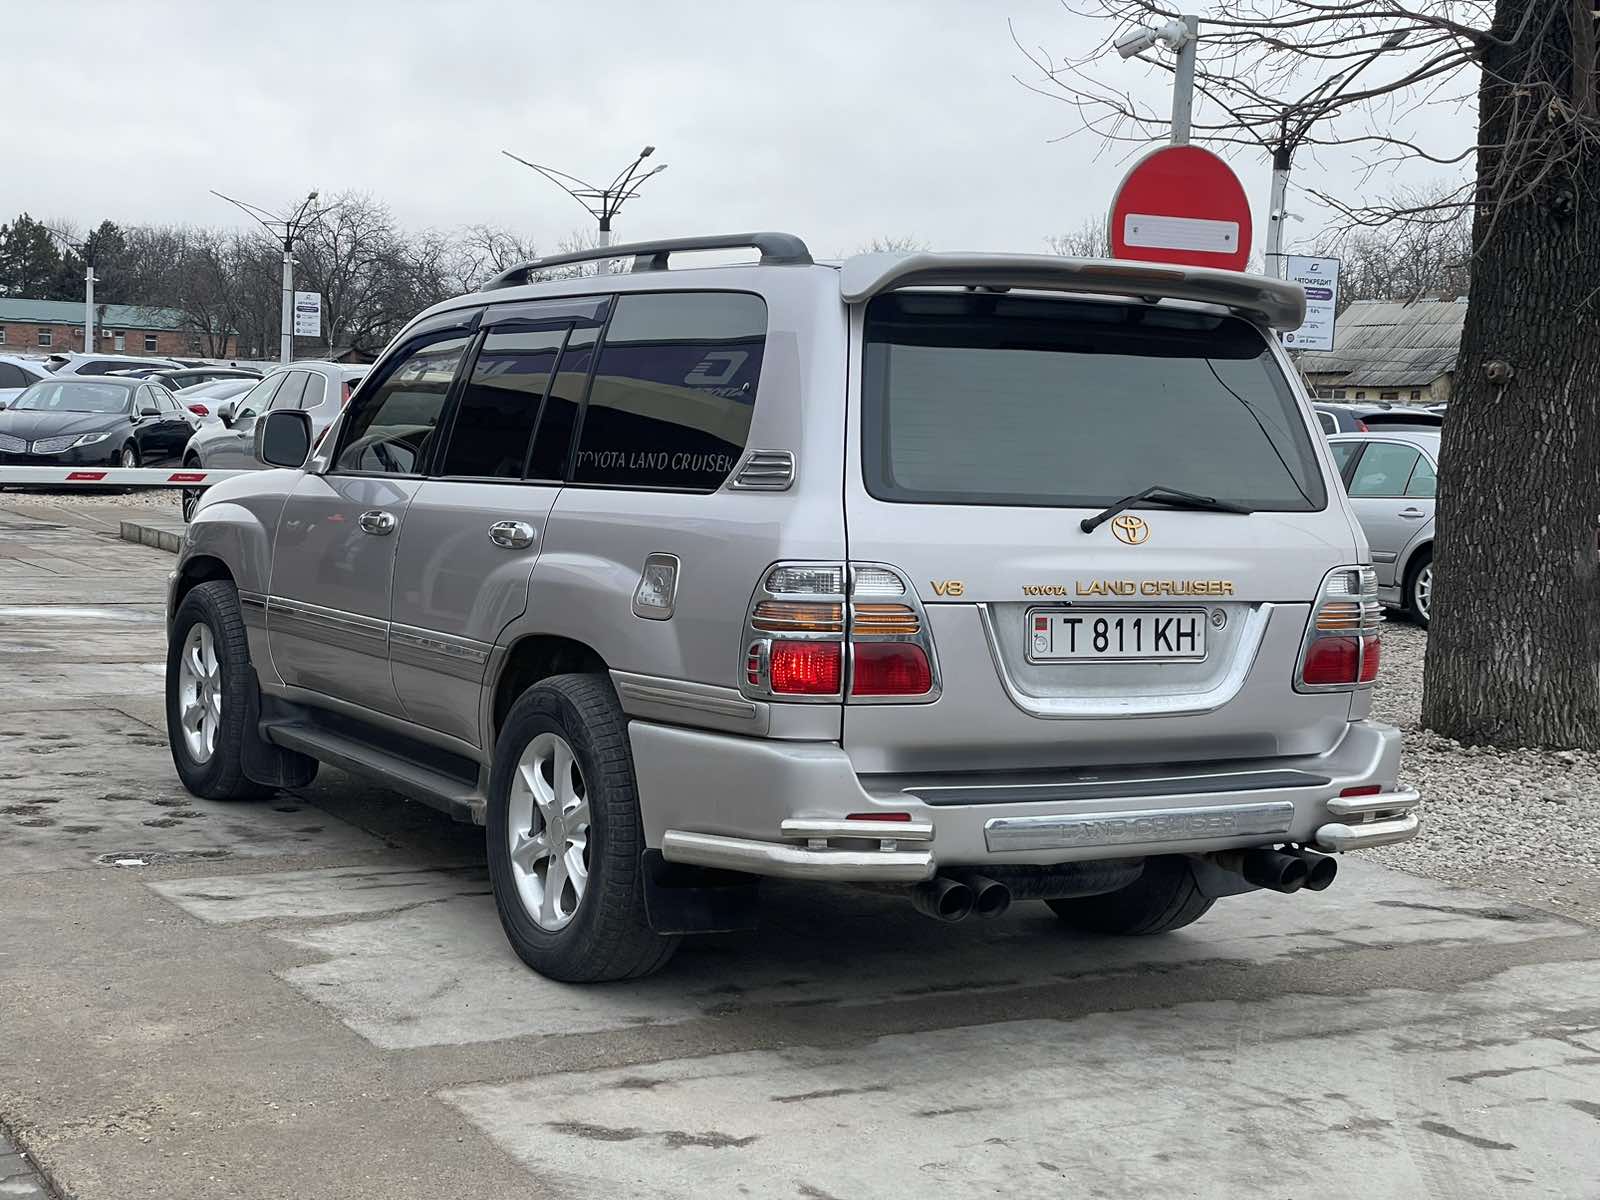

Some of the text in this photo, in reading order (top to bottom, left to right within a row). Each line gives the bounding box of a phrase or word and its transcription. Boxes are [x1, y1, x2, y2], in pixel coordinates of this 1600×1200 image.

[629, 451, 668, 472] LAND
[671, 453, 733, 473] CRUISER
[930, 580, 964, 596] V8
[1023, 580, 1234, 596] TOYOTA LAND CRUISER
[1063, 617, 1196, 653] T 811 KH
[1060, 814, 1240, 838] LAND CRUISER
